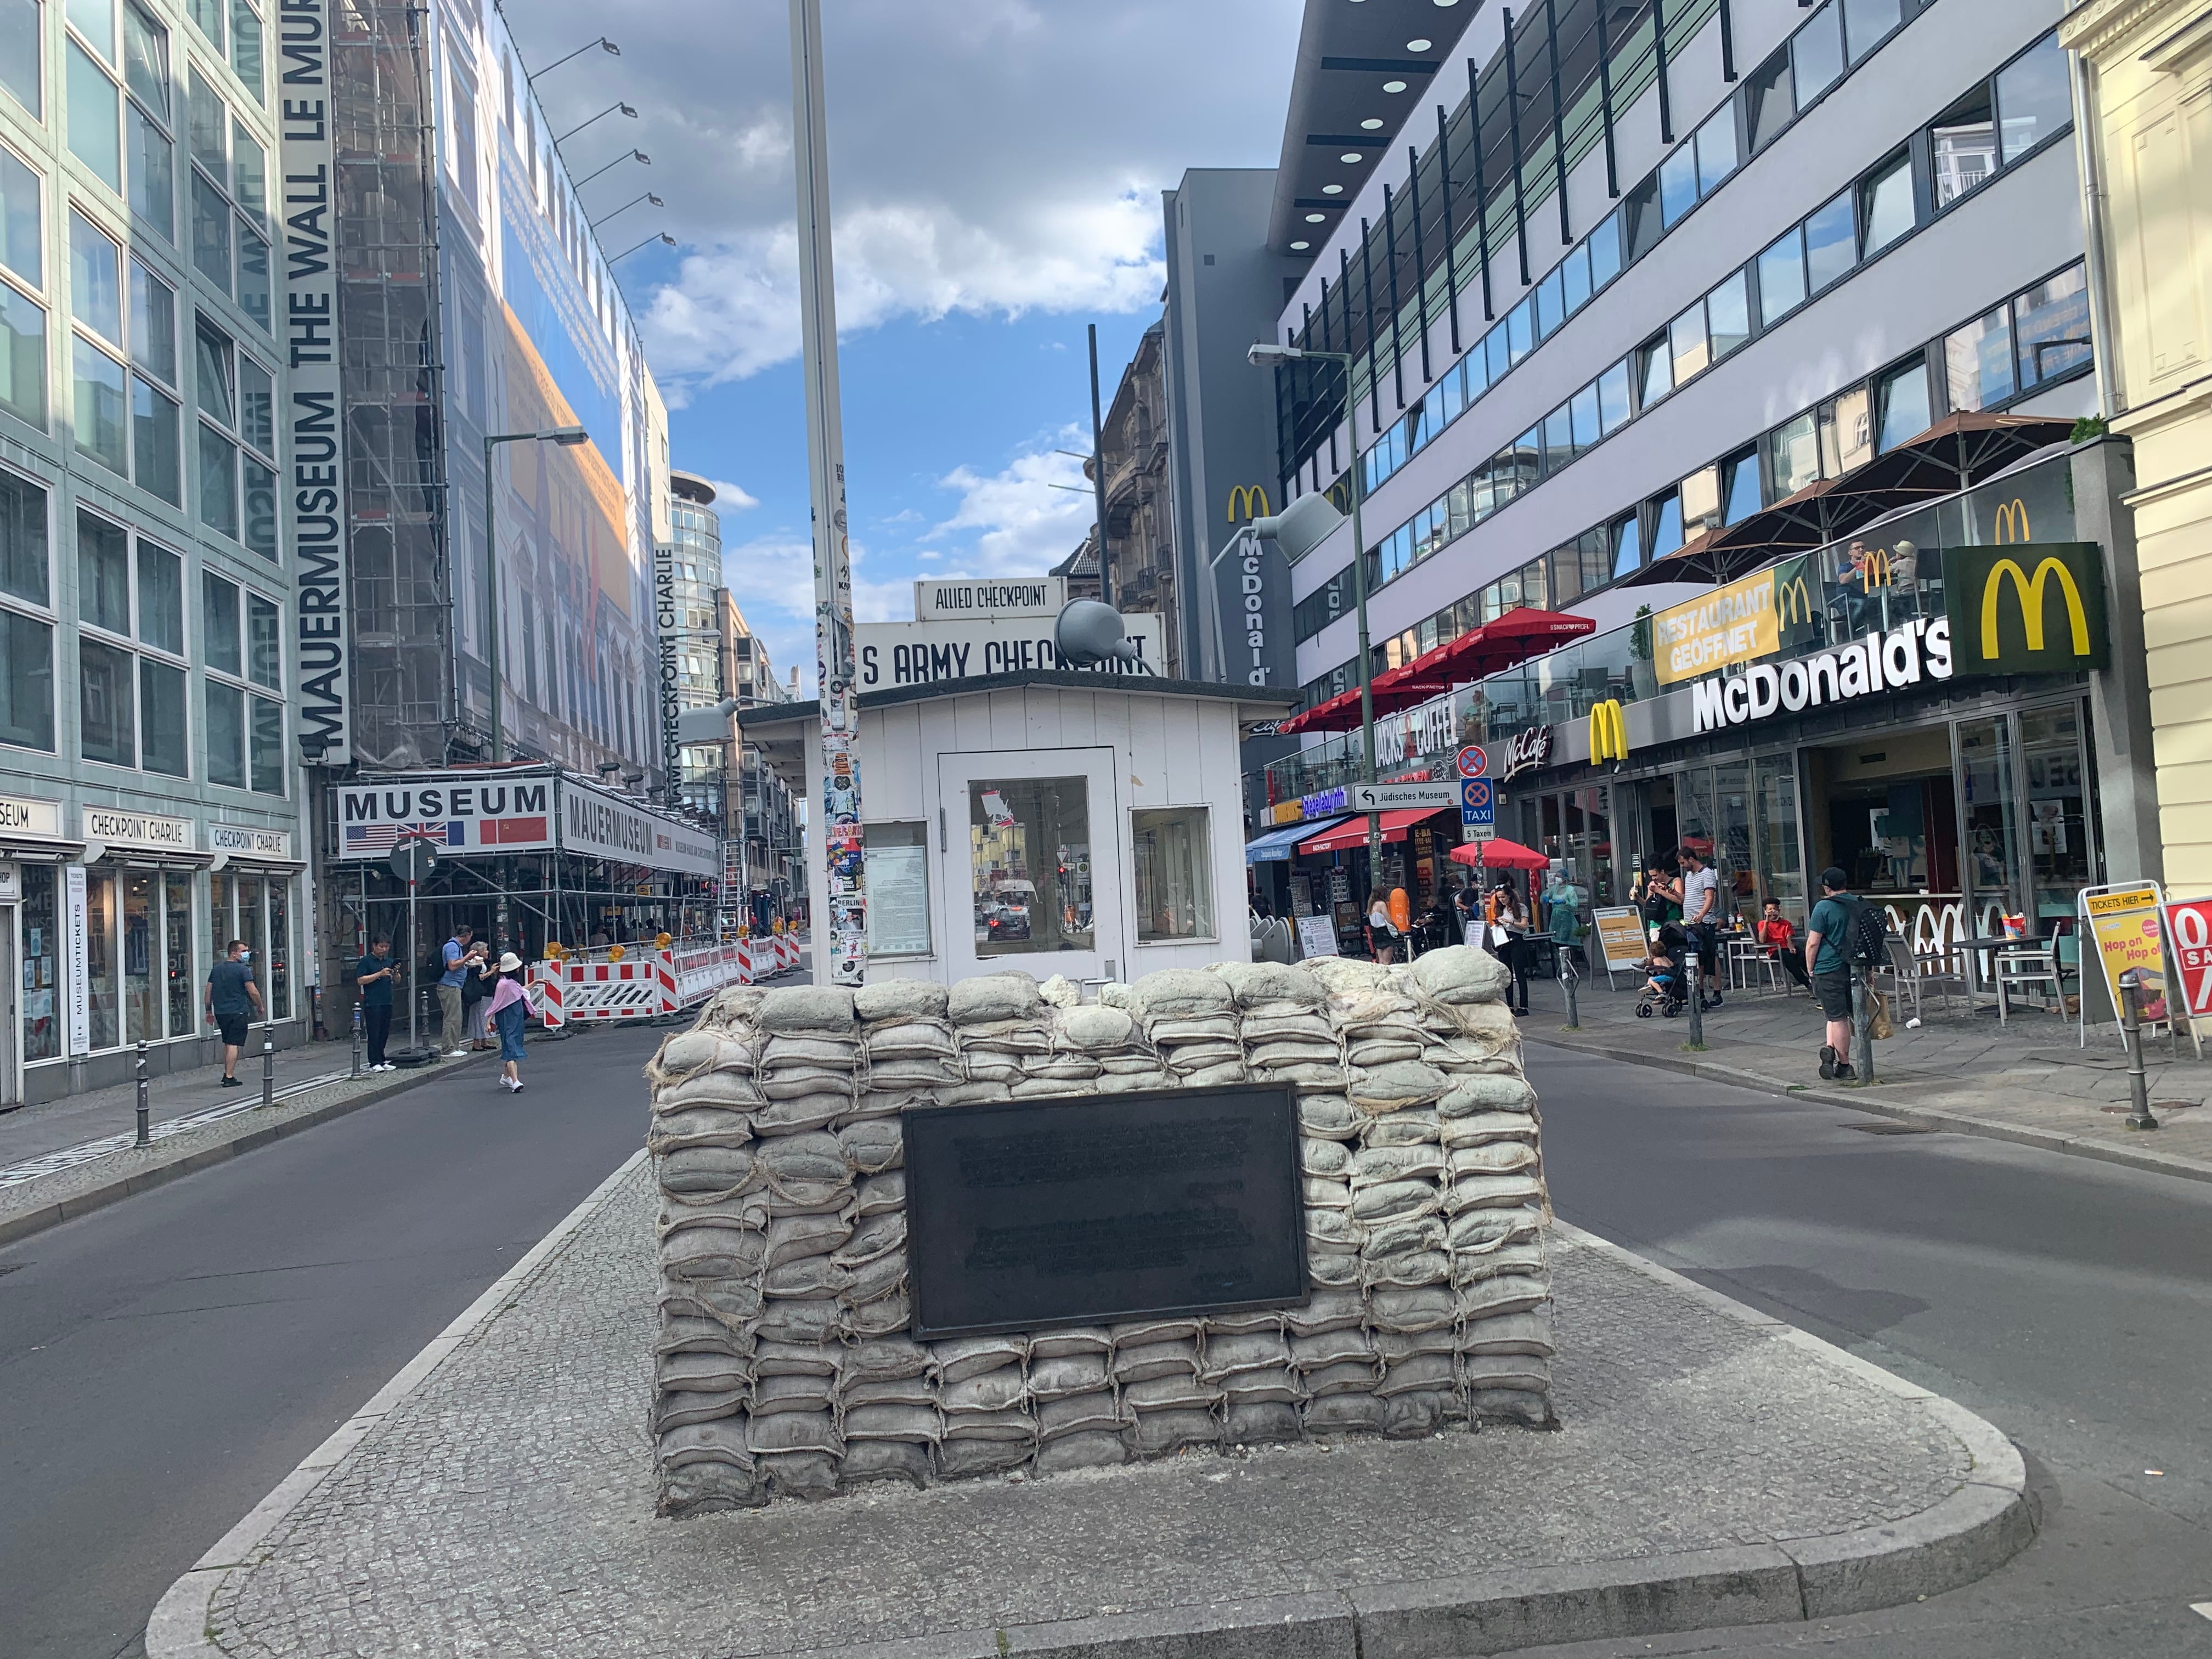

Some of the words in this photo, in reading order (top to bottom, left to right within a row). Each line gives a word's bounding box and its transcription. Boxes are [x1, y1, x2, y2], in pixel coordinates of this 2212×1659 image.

[284, 99, 325, 141] LE
[286, 163, 329, 280] WALL
[289, 293, 331, 369] THE
[293, 391, 343, 747] MAUERMUSEUM
[656, 549, 676, 629] CHARLIE
[936, 587, 972, 610] ALLIED
[977, 584, 1047, 607] CHECKPOINT
[1657, 582, 1771, 647] RESTAURANT
[894, 641, 971, 684] ARMY
[1670, 620, 1758, 673] GEÖFFNET
[1693, 616, 1953, 733] McDonald's
[1415, 695, 1459, 757] COFFEE
[1504, 724, 1547, 777] McCafé
[345, 785, 546, 821] MUSEUM
[1379, 792, 1417, 802] Jüdisches
[1419, 791, 1450, 799] Museum
[1465, 810, 1491, 821] TAXI
[91, 814, 146, 839] CHECKPOINT
[149, 821, 183, 843] CHARLIE
[215, 829, 255, 850] CHECKPOINT
[257, 834, 281, 853] CHARLIE
[569, 794, 653, 856] MAUERMUSEUM
[1473, 830, 1492, 838] Taxen
[2091, 898, 2121, 910] TICKETS
[2123, 895, 2139, 906] HIER
[75, 904, 83, 1015] MUSEUMTICKETS
[2104, 939, 2126, 953] Hop
[2129, 936, 2142, 947] on
[2126, 948, 2148, 961] Hop
